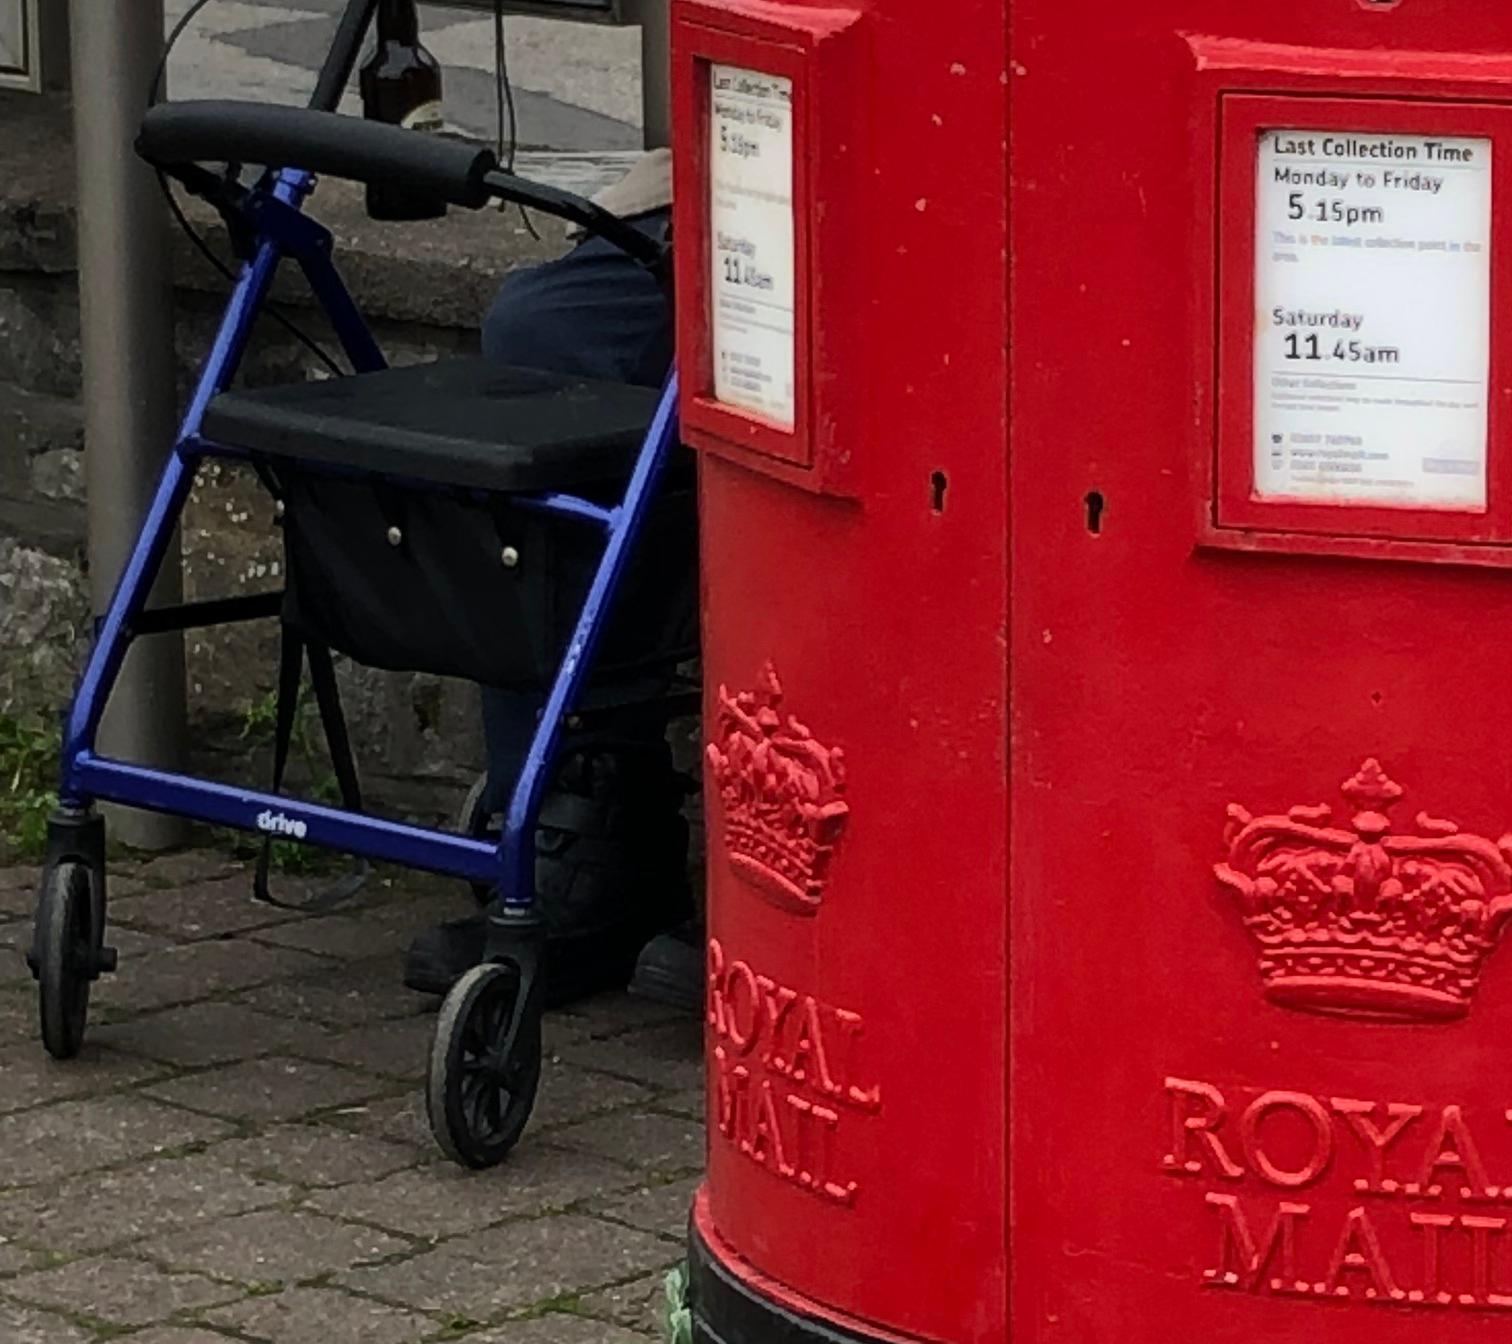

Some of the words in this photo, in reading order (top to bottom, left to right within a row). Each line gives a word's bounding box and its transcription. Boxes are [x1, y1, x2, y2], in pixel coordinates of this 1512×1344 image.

[1273, 136, 1315, 156] Last
[1322, 137, 1418, 160] Collection
[1424, 142, 1474, 162] Time
[1274, 167, 1350, 190] Monday
[1356, 172, 1376, 188] to
[1383, 170, 1444, 194] Friday
[1287, 192, 1385, 227] 5.15pm
[1272, 307, 1364, 332] Saturday
[1284, 333, 1400, 364] 11.45am
[256, 808, 308, 839] drive
[708, 937, 882, 1114] ROYAL
[714, 1044, 860, 1208] MAIL
